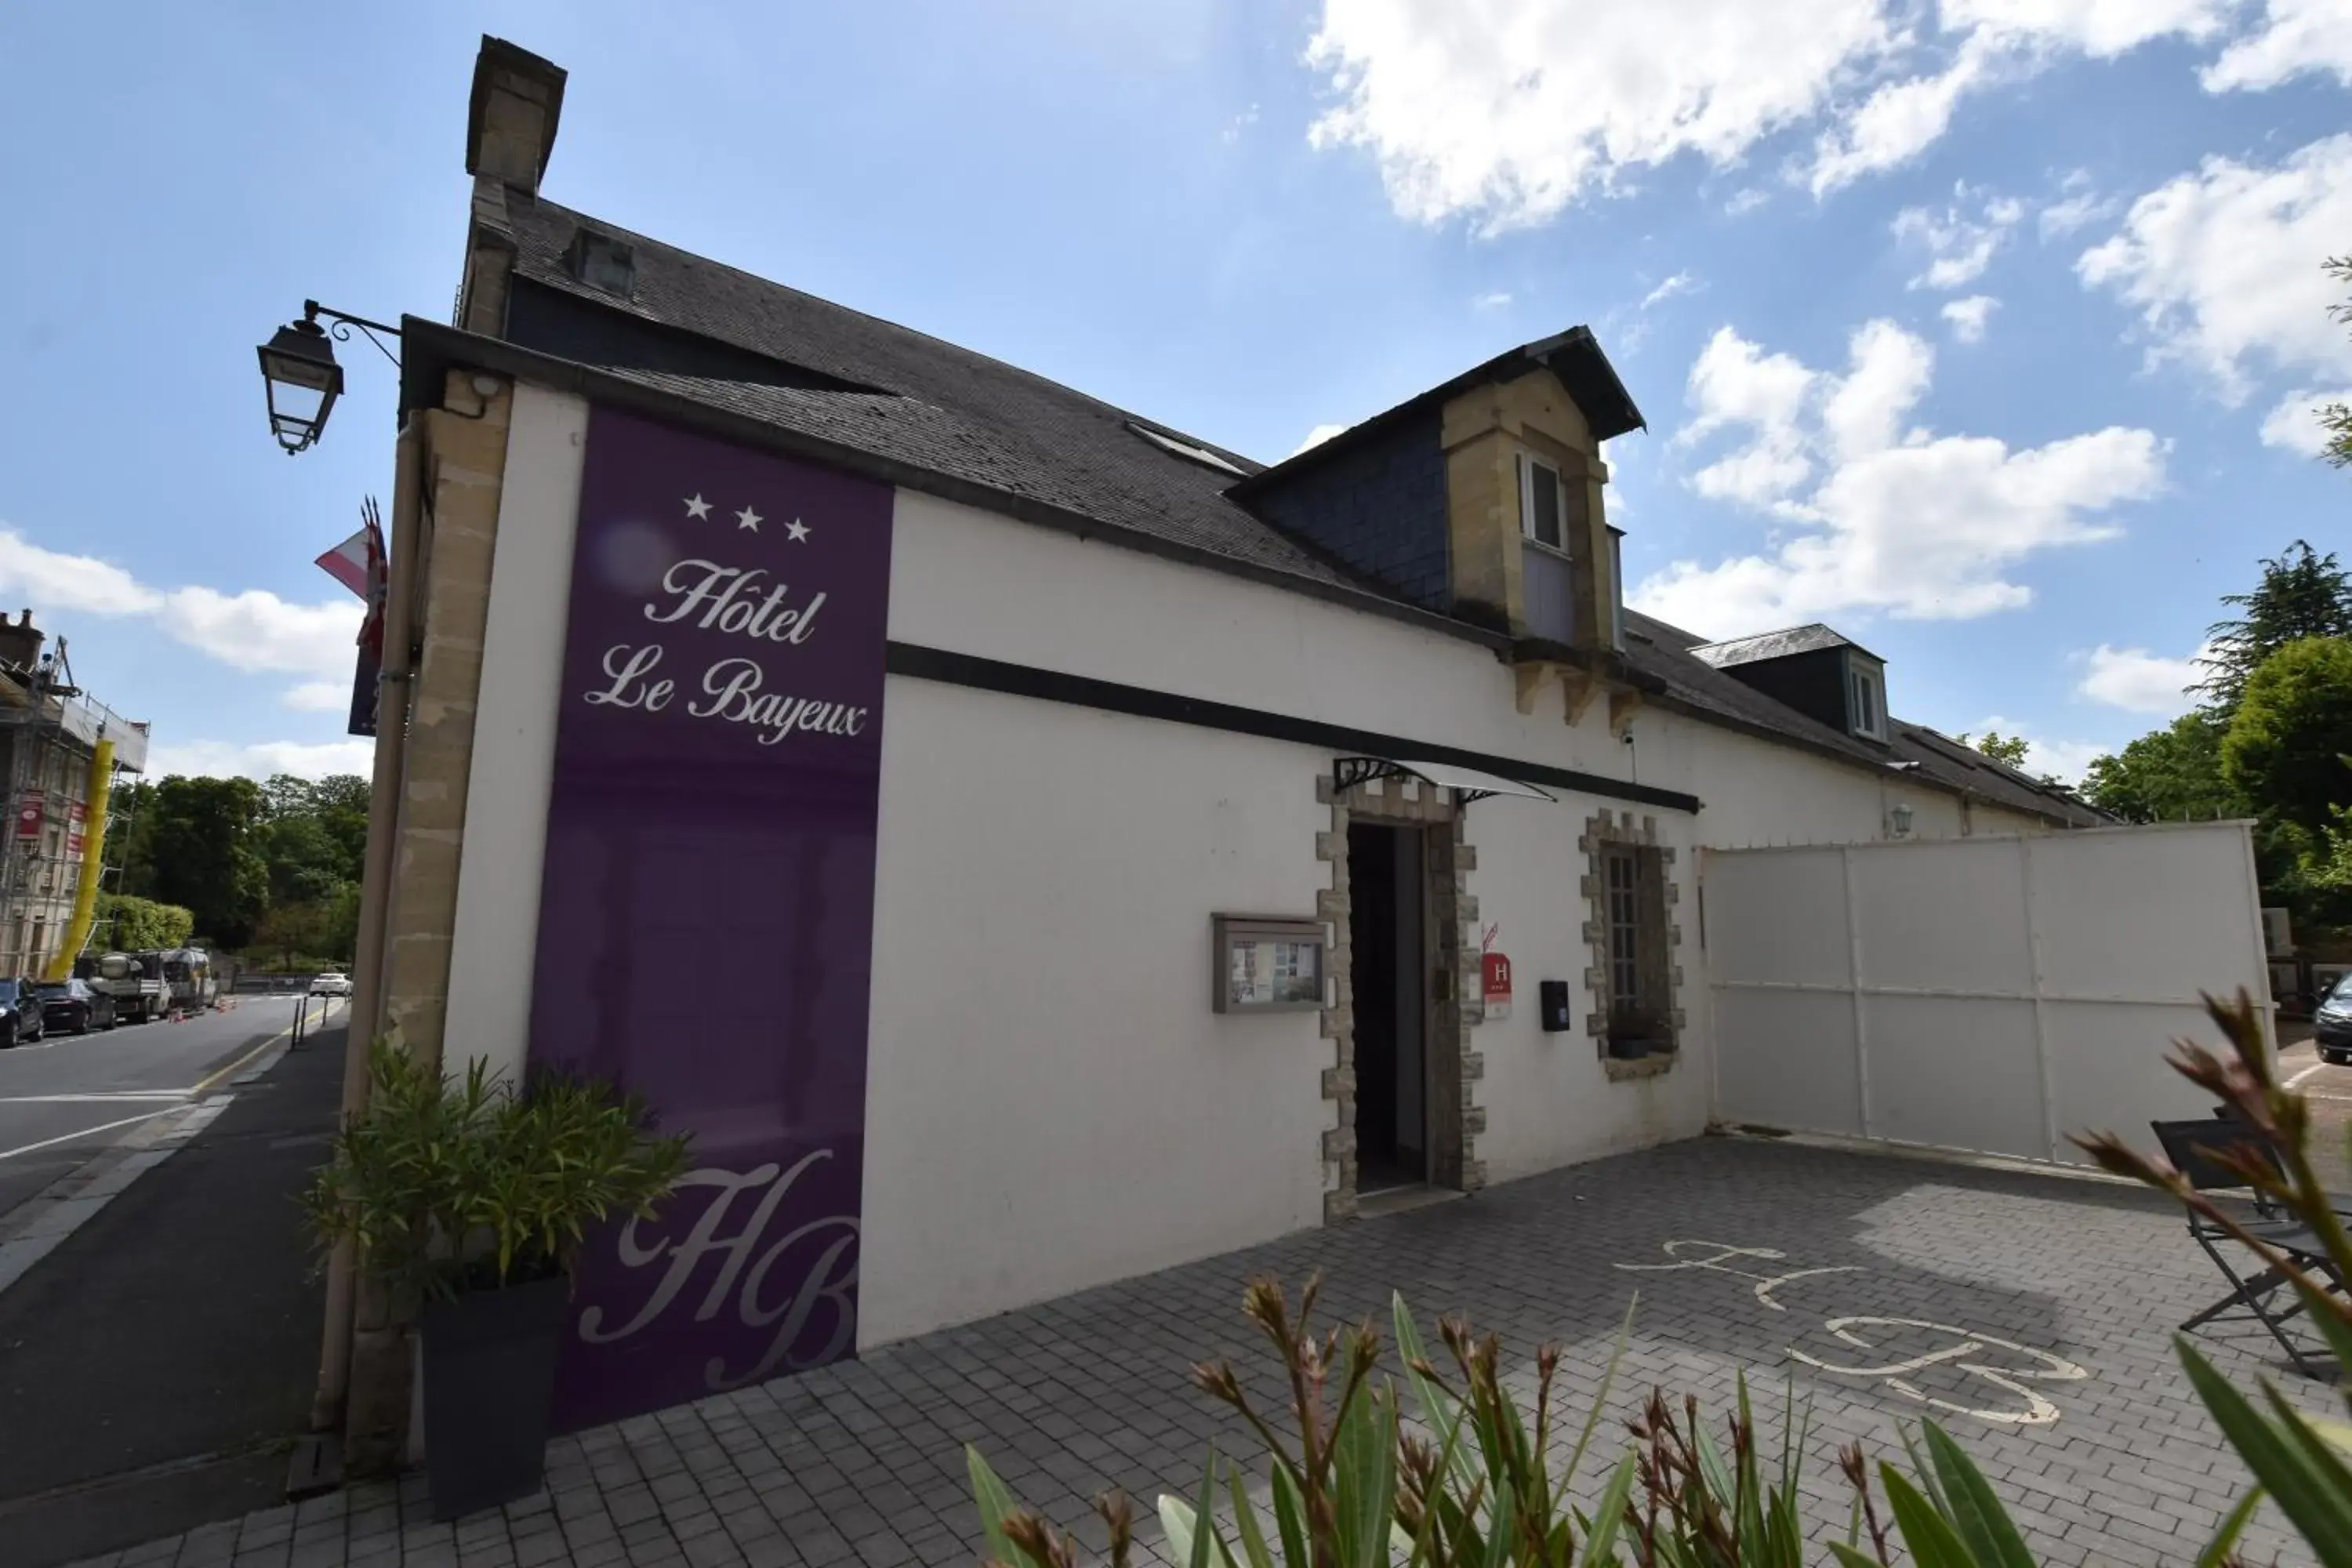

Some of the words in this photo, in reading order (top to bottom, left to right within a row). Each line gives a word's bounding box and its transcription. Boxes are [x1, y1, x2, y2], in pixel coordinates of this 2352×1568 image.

[644, 558, 827, 645] Hôtel
[583, 644, 675, 711] Le
[687, 658, 867, 745] Bayeux
[1494, 963, 1507, 982] H
